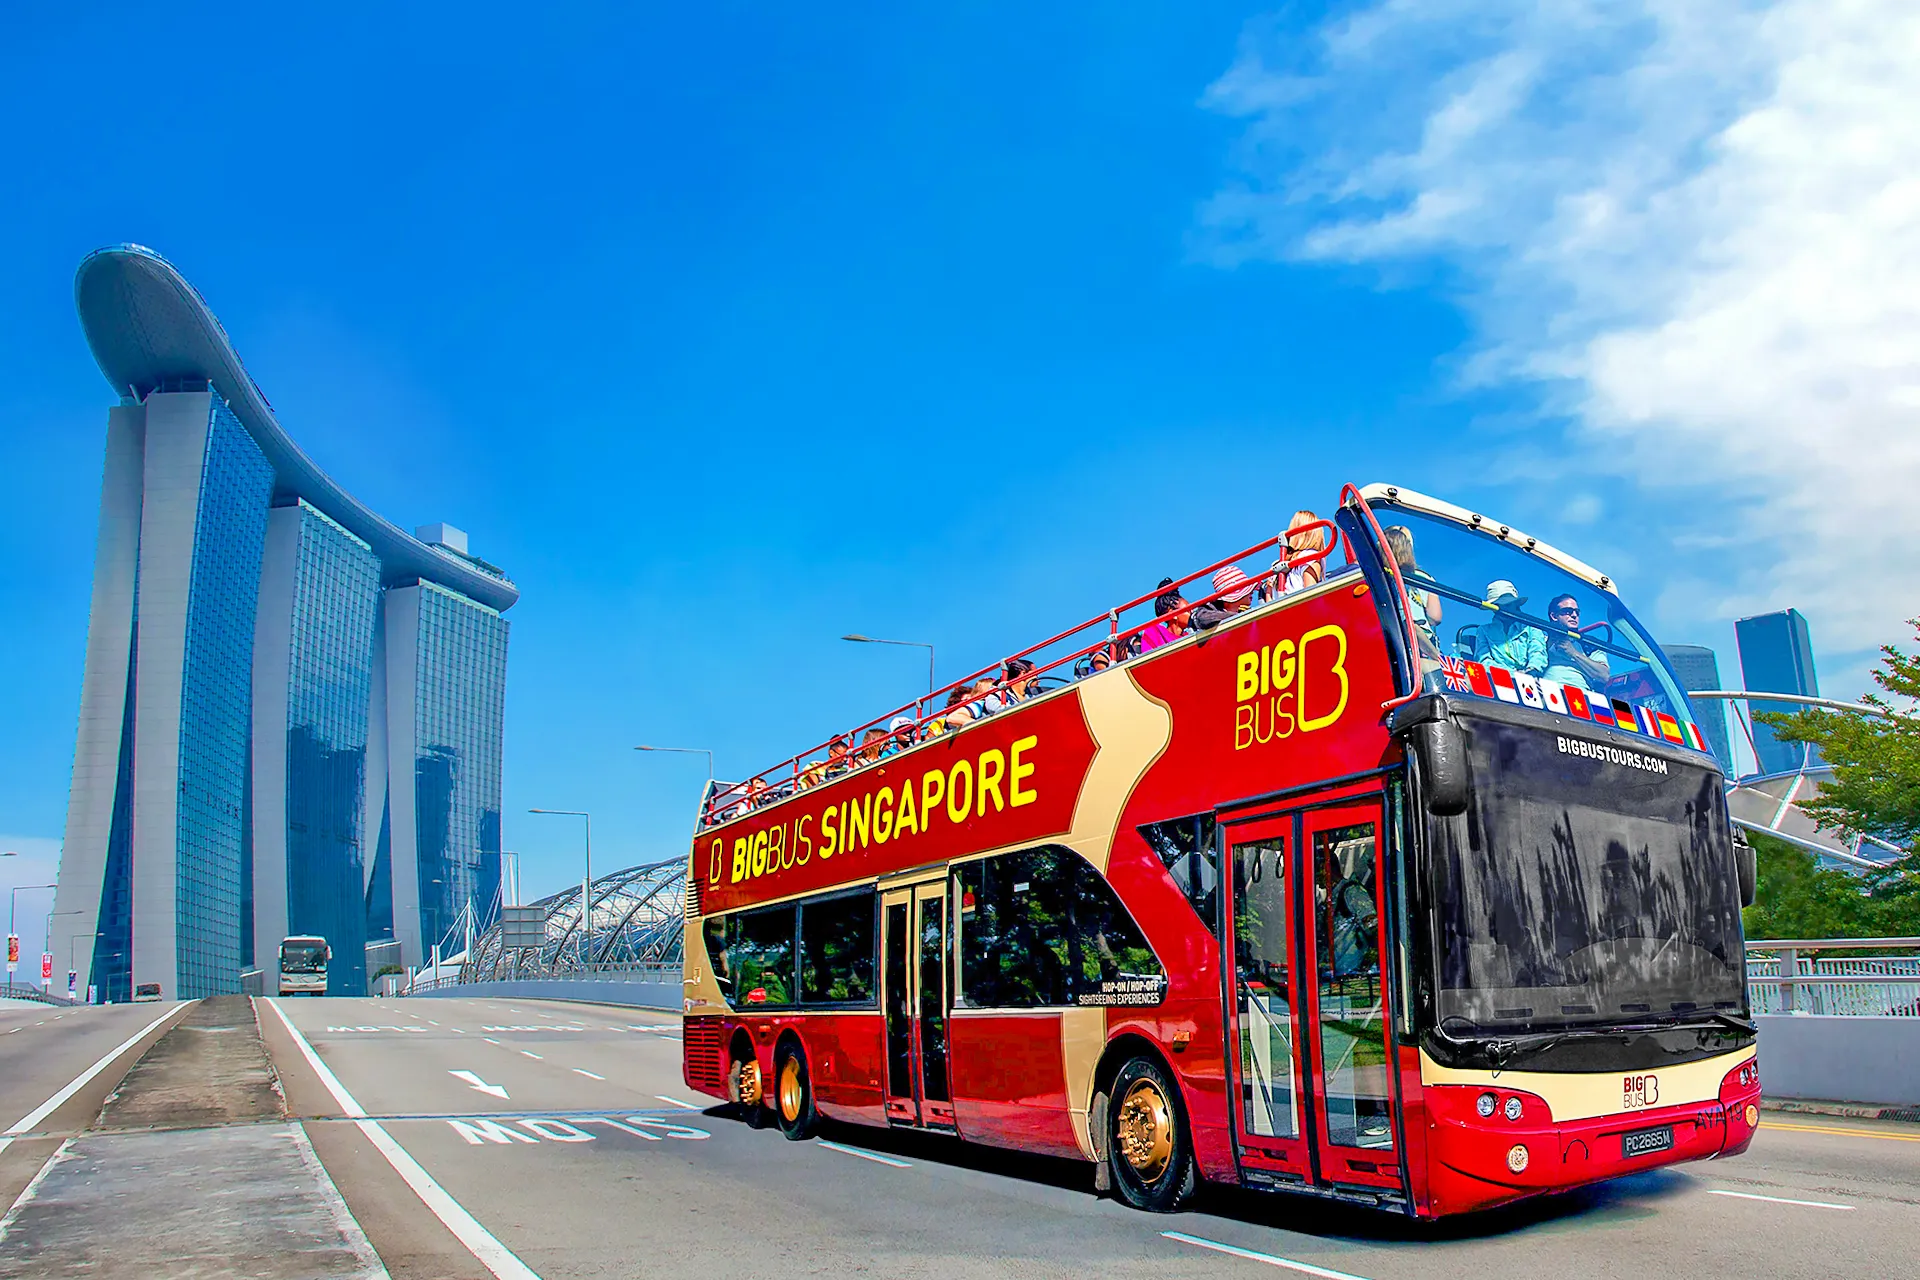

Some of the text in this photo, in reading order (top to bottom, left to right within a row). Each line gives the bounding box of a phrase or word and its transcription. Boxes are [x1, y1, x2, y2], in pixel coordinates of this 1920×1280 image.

[1236, 638, 1296, 703] BIG
[1234, 691, 1296, 751] BUS
[1556, 735, 1668, 775] BIGBUSTOURS.COM
[818, 734, 1038, 860] SINGAPORE
[1079, 992, 1160, 1005] SIGHTSEEING EXPERIENCES
[1102, 981, 1126, 992] HOP-ON
[1130, 980, 1159, 992] HOP-OFF
[1624, 1076, 1643, 1093] BIG
[1624, 1093, 1643, 1109] BUS
[447, 1116, 711, 1145] SLOW
